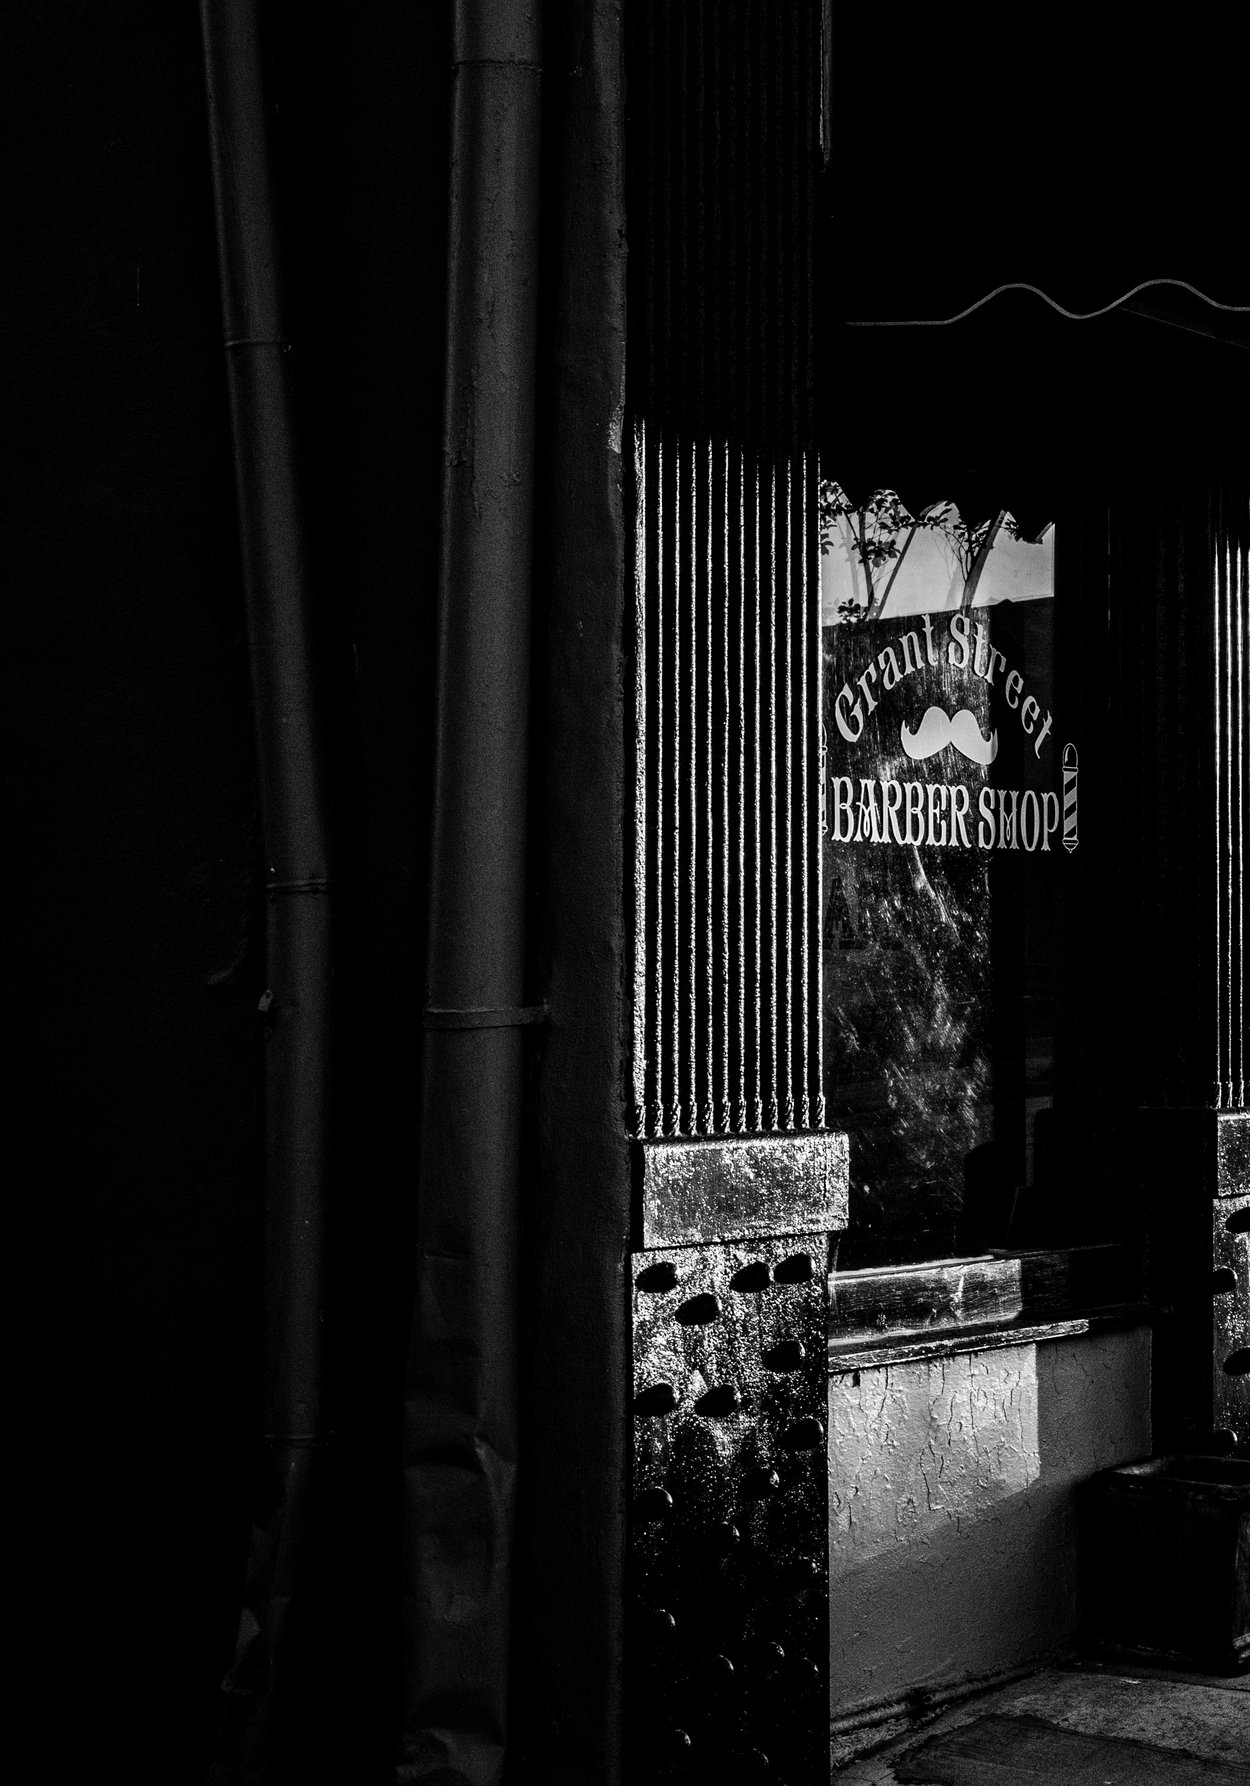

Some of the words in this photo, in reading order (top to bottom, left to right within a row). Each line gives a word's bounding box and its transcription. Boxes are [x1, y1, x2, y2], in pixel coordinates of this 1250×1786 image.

[835, 613, 939, 743] Grant
[948, 613, 1053, 759] Street
[831, 776, 972, 848] BARBER
[978, 786, 1060, 852] SHOP
